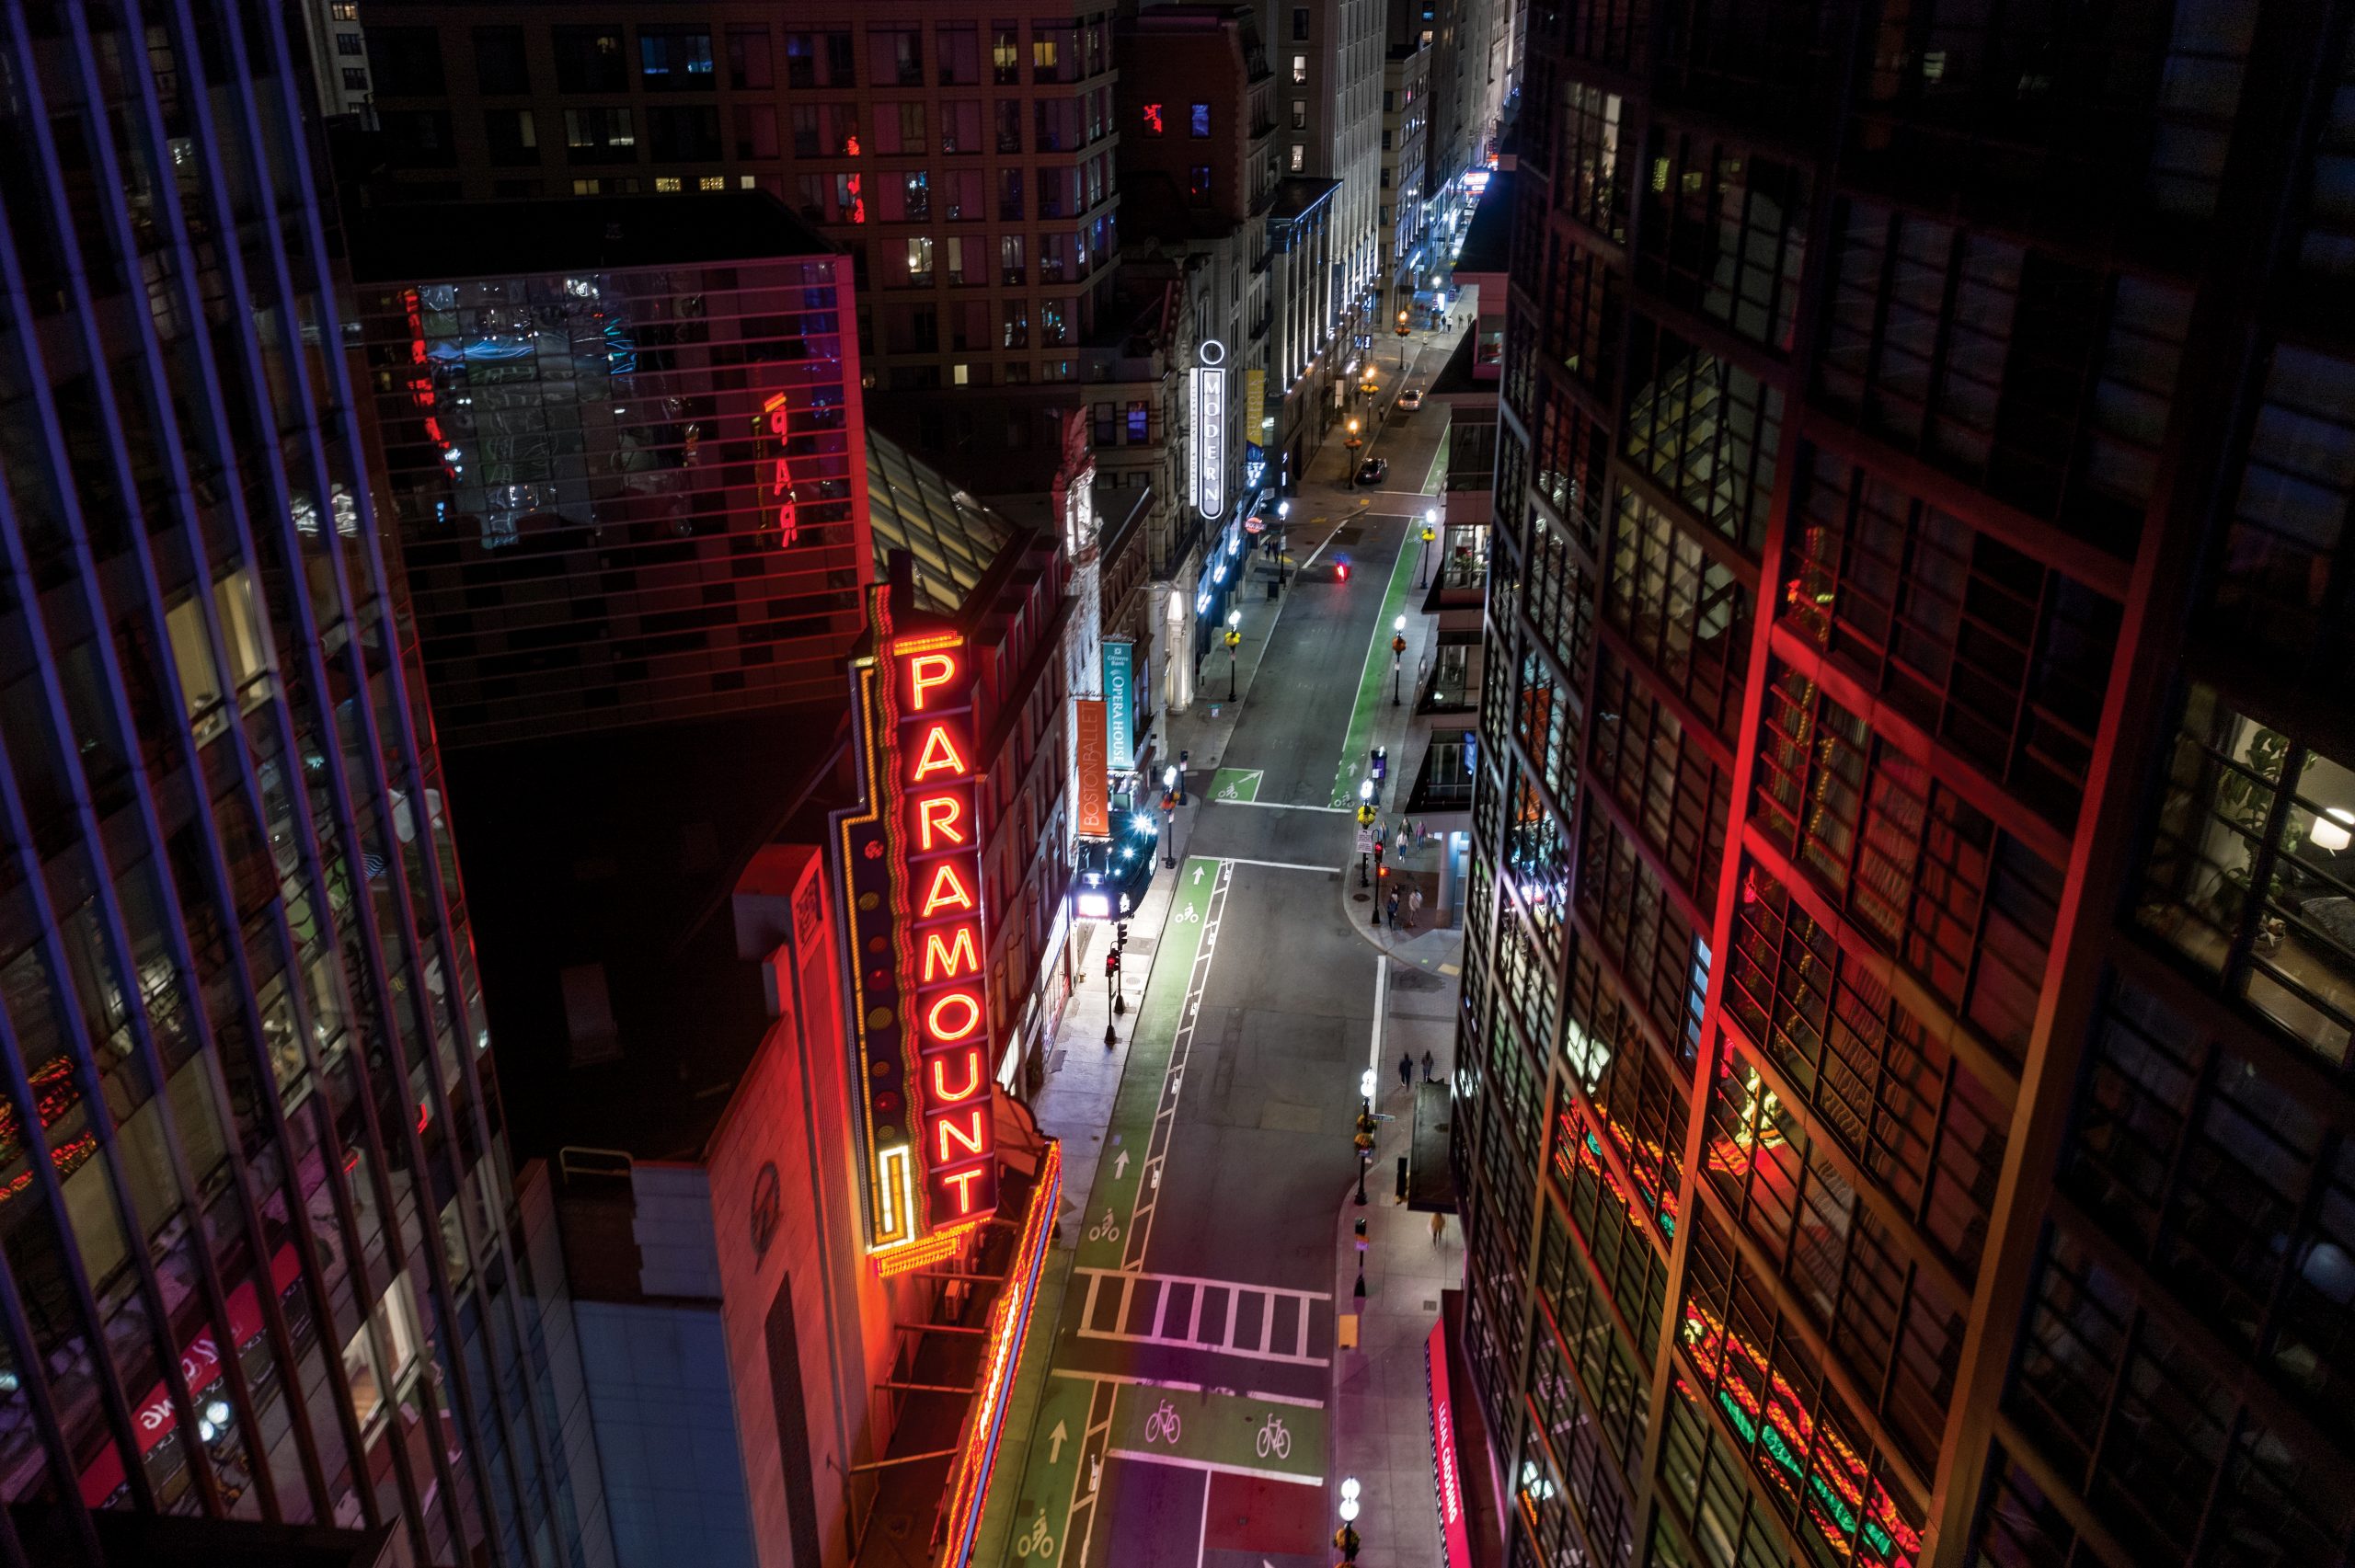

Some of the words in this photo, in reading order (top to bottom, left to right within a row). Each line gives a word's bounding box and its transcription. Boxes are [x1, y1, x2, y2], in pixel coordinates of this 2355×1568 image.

[1204, 382, 1220, 501] MODERN
[1112, 676, 1124, 724] OPERA
[1113, 725, 1124, 763] HOUSE
[912, 655, 982, 1215] PARAMOUNT
